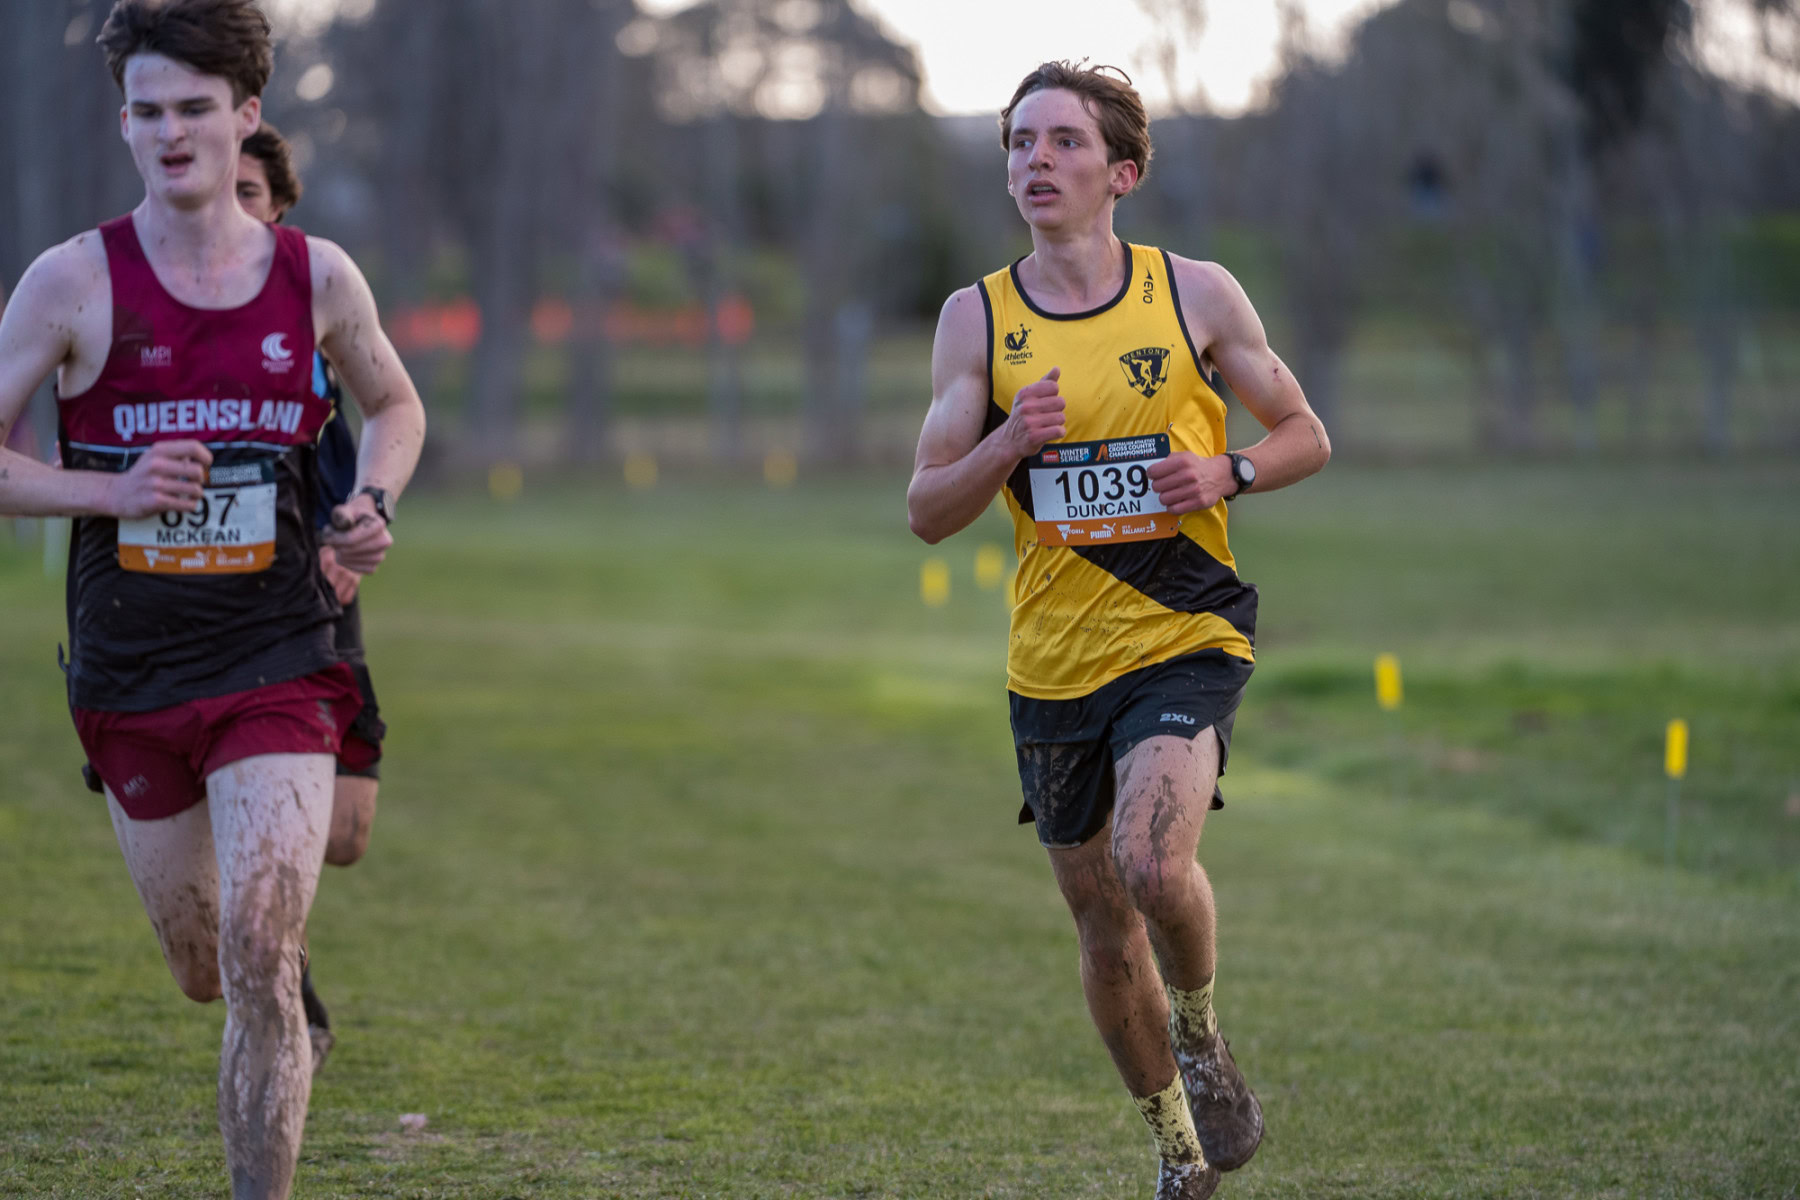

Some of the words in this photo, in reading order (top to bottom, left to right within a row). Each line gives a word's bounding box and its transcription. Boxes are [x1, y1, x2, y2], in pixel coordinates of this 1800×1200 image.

[1142, 280, 1154, 305] EVO
[1059, 447, 1089, 456] WINTER
[1108, 445, 1128, 453] CROSS
[1128, 442, 1156, 450] COUNTRY
[1109, 447, 1157, 458] CHAMPIONSHIPS
[1060, 454, 1084, 462] SERIES
[1055, 465, 1148, 504] 1039
[1067, 500, 1141, 518] DUNCAN
[156, 528, 241, 544] MCKEAN
[1090, 530, 1112, 540] PUMA
[1160, 712, 1196, 725] 2XU
